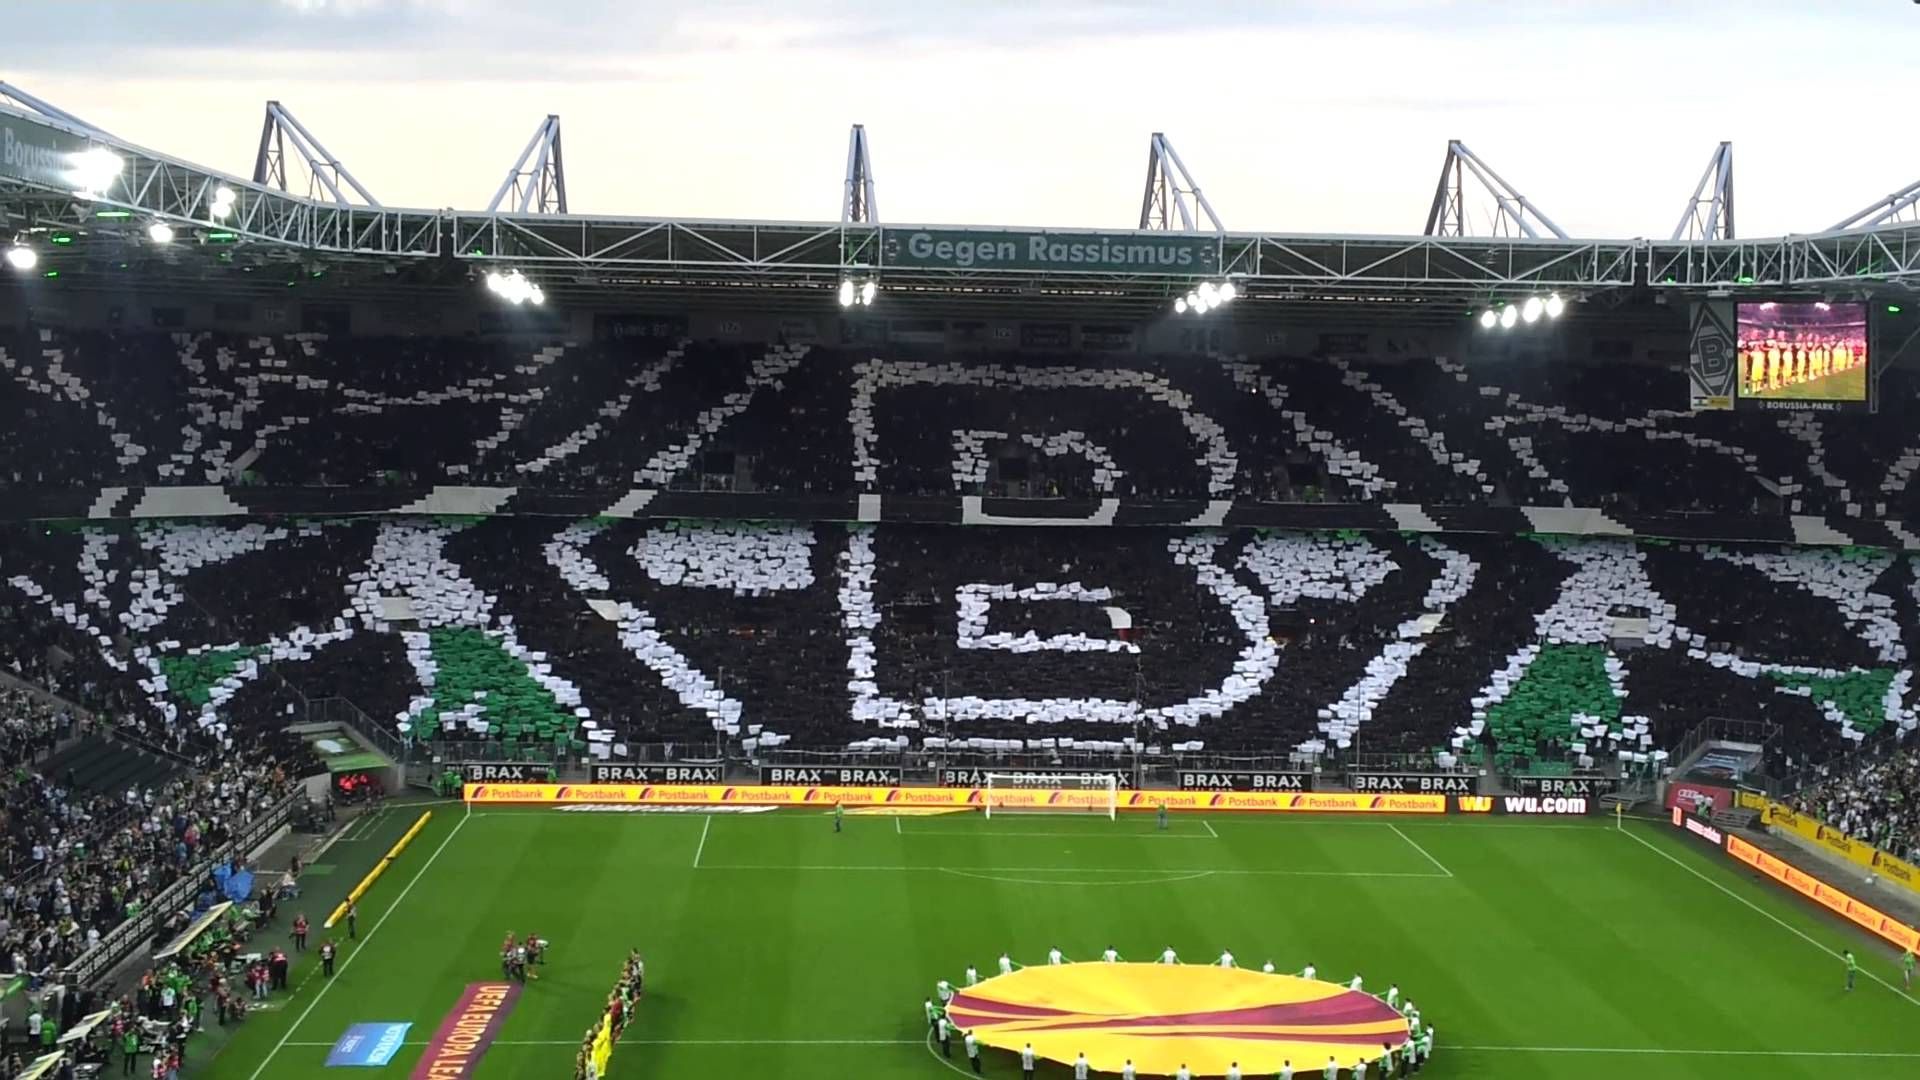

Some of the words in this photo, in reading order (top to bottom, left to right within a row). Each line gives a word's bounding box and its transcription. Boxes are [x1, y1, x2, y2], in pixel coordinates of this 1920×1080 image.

[908, 233, 1016, 265] Gegen
[1028, 236, 1192, 265] Rassismus
[1766, 402, 1835, 410] BORUSSIA-PARK
[473, 765, 523, 779] BRAX
[598, 767, 648, 780] BRAX
[666, 767, 717, 780] BRAX
[771, 769, 821, 782] BRAX
[840, 769, 889, 782] BRAX
[945, 771, 993, 783] BRAX
[1013, 772, 1061, 784] BRAX
[1184, 774, 1232, 787] BRAX
[1253, 775, 1302, 787] BRAX
[1356, 777, 1404, 789] BRAX
[1421, 777, 1469, 790] BRAX
[1541, 780, 1589, 792] BRAX
[492, 788, 543, 799] Postbank
[576, 789, 627, 800] Postbank
[659, 790, 709, 801] Postbank
[741, 790, 791, 801] Postbank
[823, 791, 873, 802] Postbank
[905, 792, 954, 802] Postbank
[992, 793, 1035, 803] ostbank
[1148, 795, 1197, 805] Postbank
[1228, 797, 1278, 807] Postbank
[1309, 798, 1358, 808] Postbank
[1389, 799, 1438, 809] Postbank
[1504, 797, 1586, 813] wu.com
[466, 985, 511, 1012] UEFA
[438, 1013, 493, 1057] EUROPA
